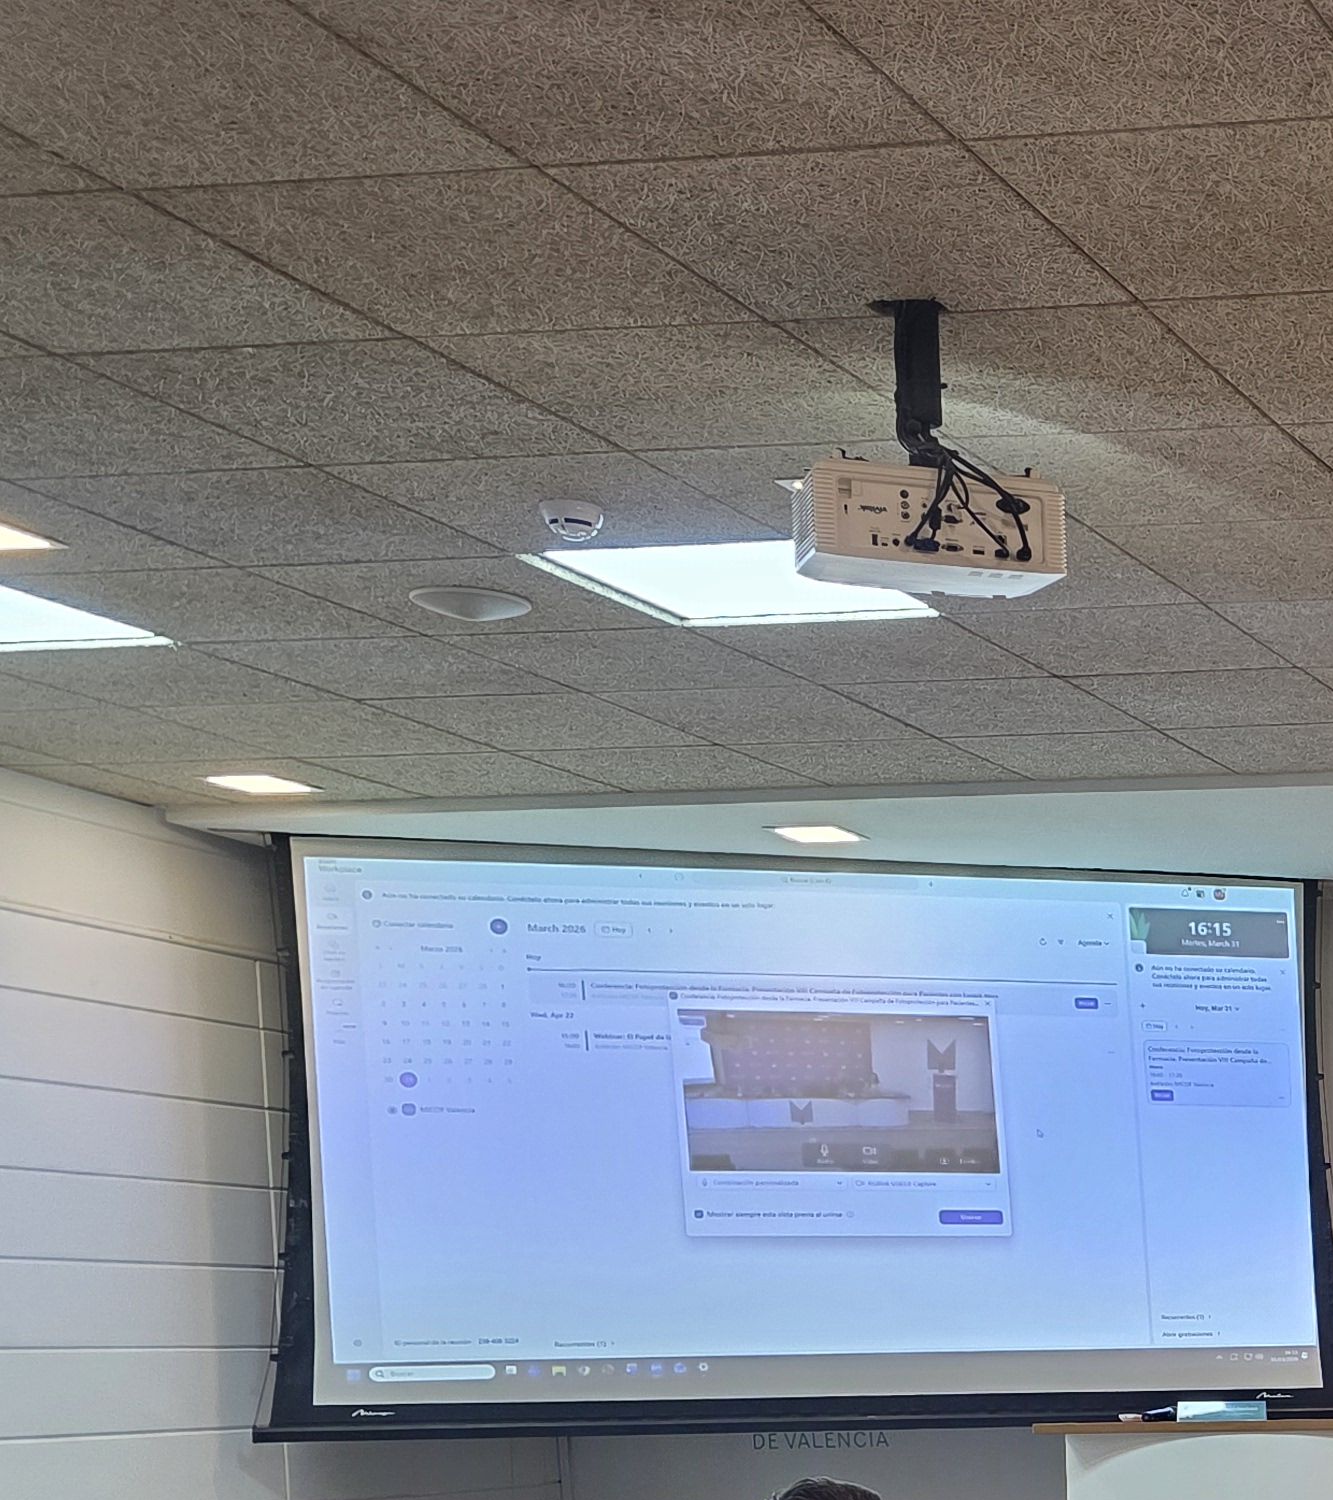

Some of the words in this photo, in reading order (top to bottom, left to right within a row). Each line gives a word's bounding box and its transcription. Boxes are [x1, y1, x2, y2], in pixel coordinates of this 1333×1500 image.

[527, 923, 559, 933] March
[562, 924, 586, 934] 2026
[1188, 922, 1232, 937] 16:15
[753, 1433, 779, 1450] DE
[784, 1431, 889, 1450] VALENCIA
